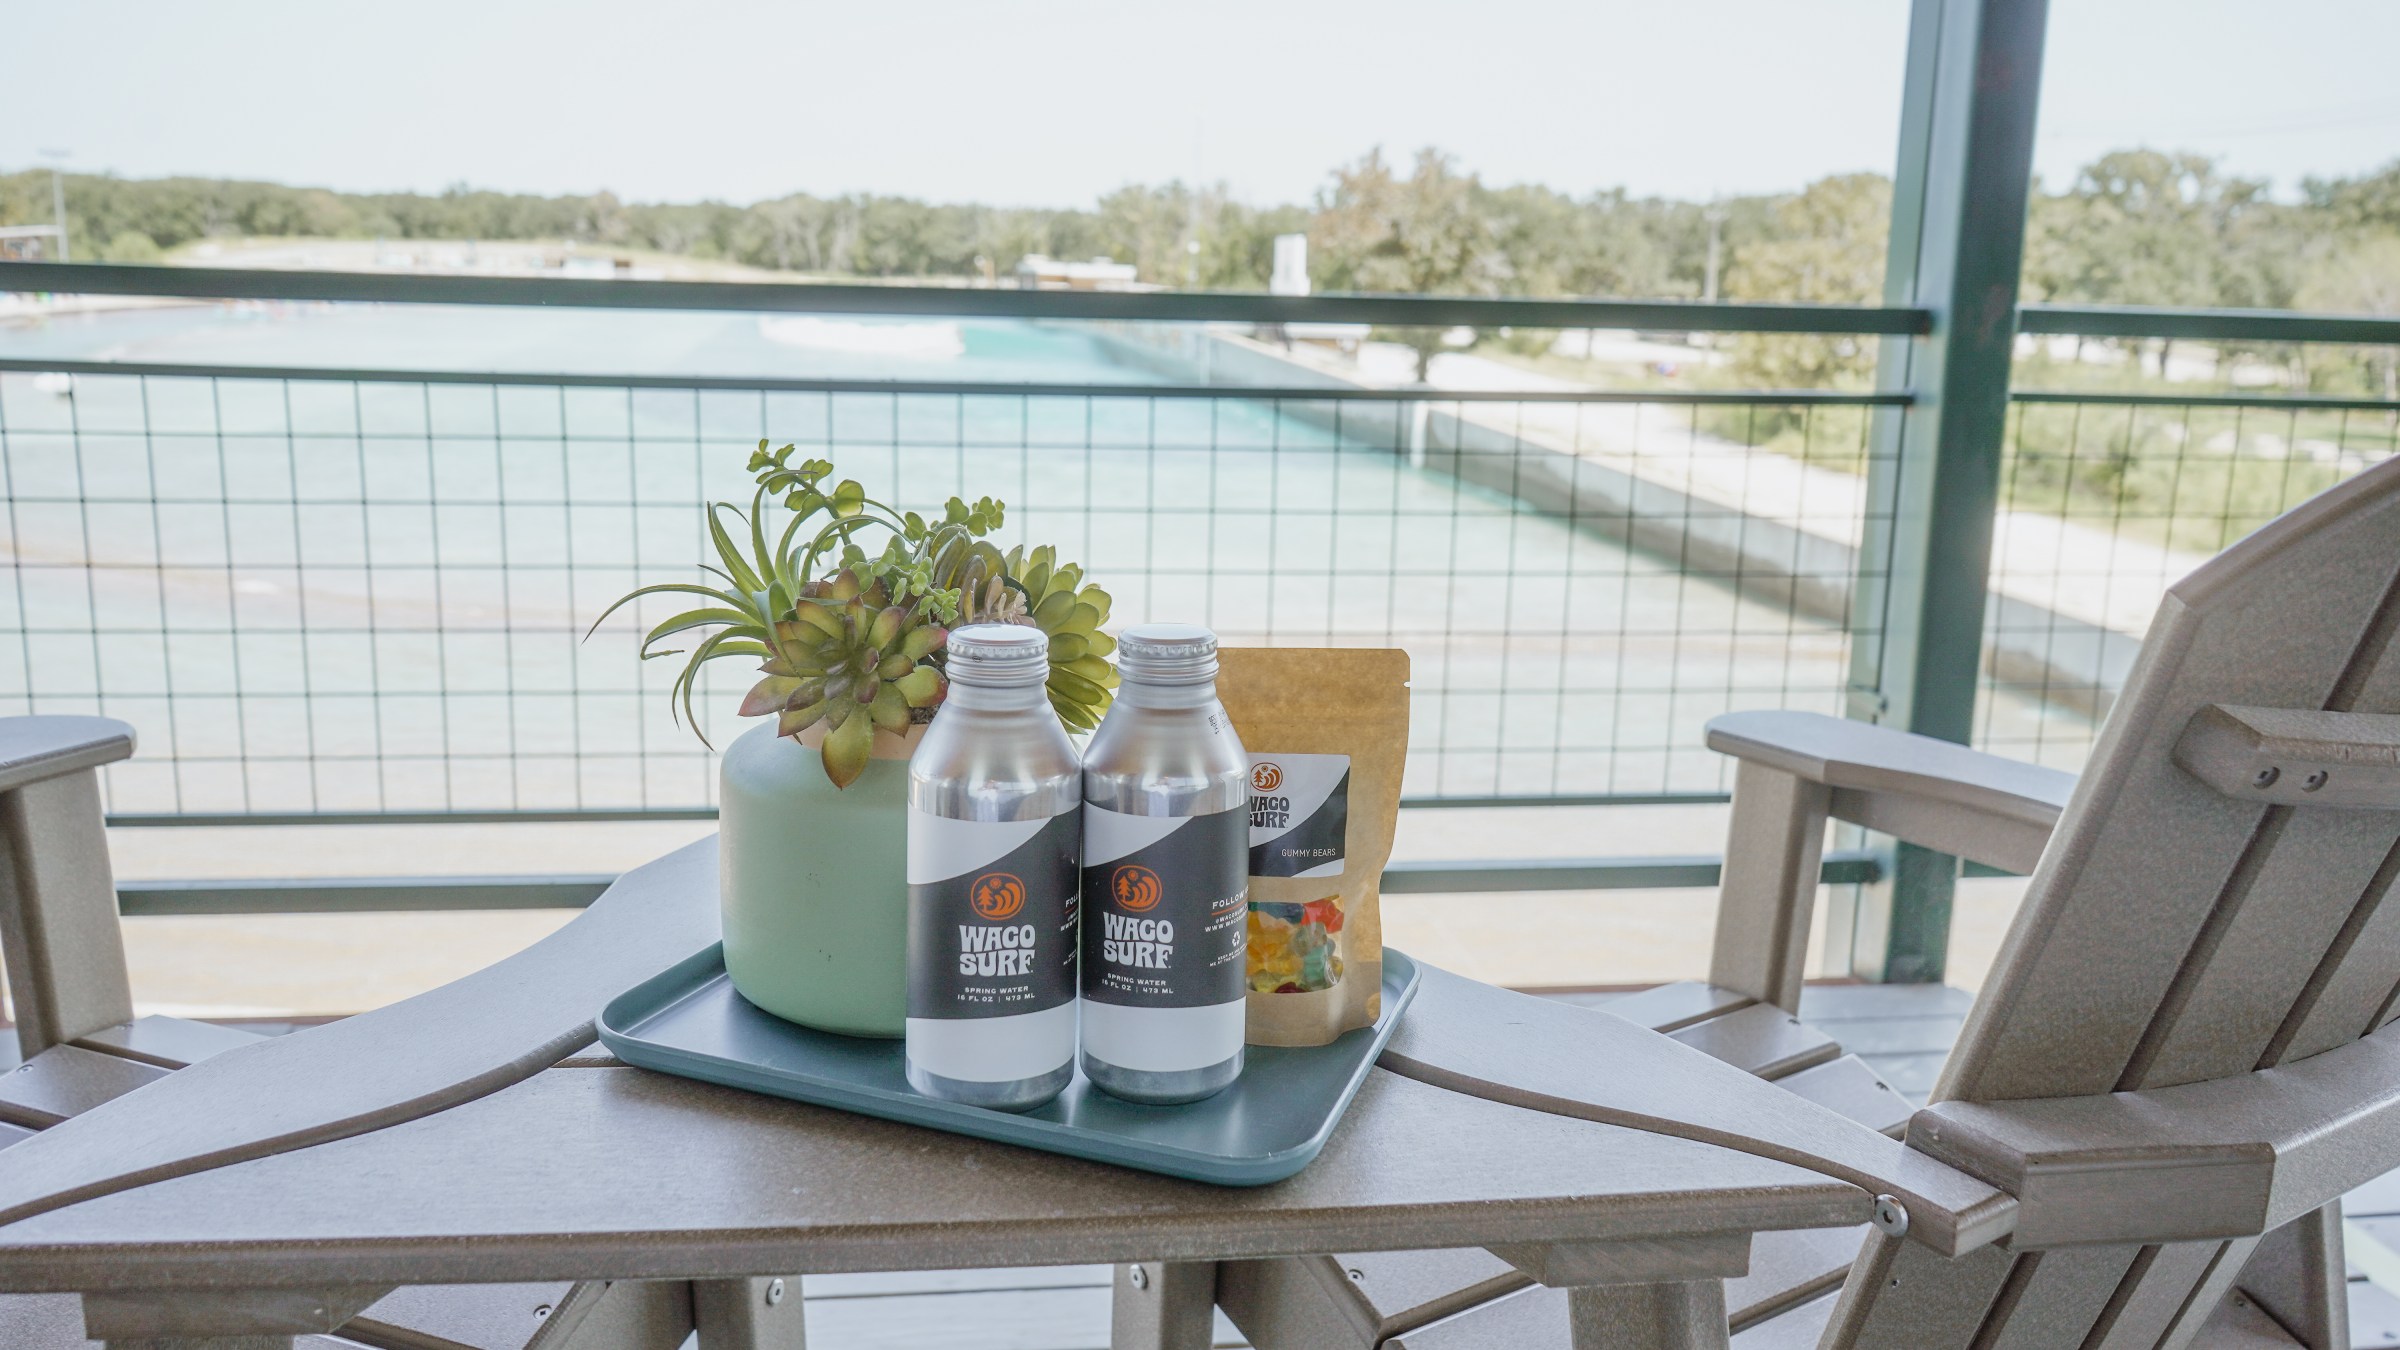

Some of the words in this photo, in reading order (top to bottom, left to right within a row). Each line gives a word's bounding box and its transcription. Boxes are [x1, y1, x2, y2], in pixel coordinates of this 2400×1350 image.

[1281, 849, 1310, 857] GUMMY
[1313, 848, 1336, 857] BEARS
[1212, 890, 1245, 909] FOLLOW
[1103, 912, 1174, 943] WACO
[959, 925, 1035, 952] WACO
[1107, 973, 1134, 983] SPRING
[999, 985, 1029, 994] WATER
[1110, 981, 1119, 989] FL
